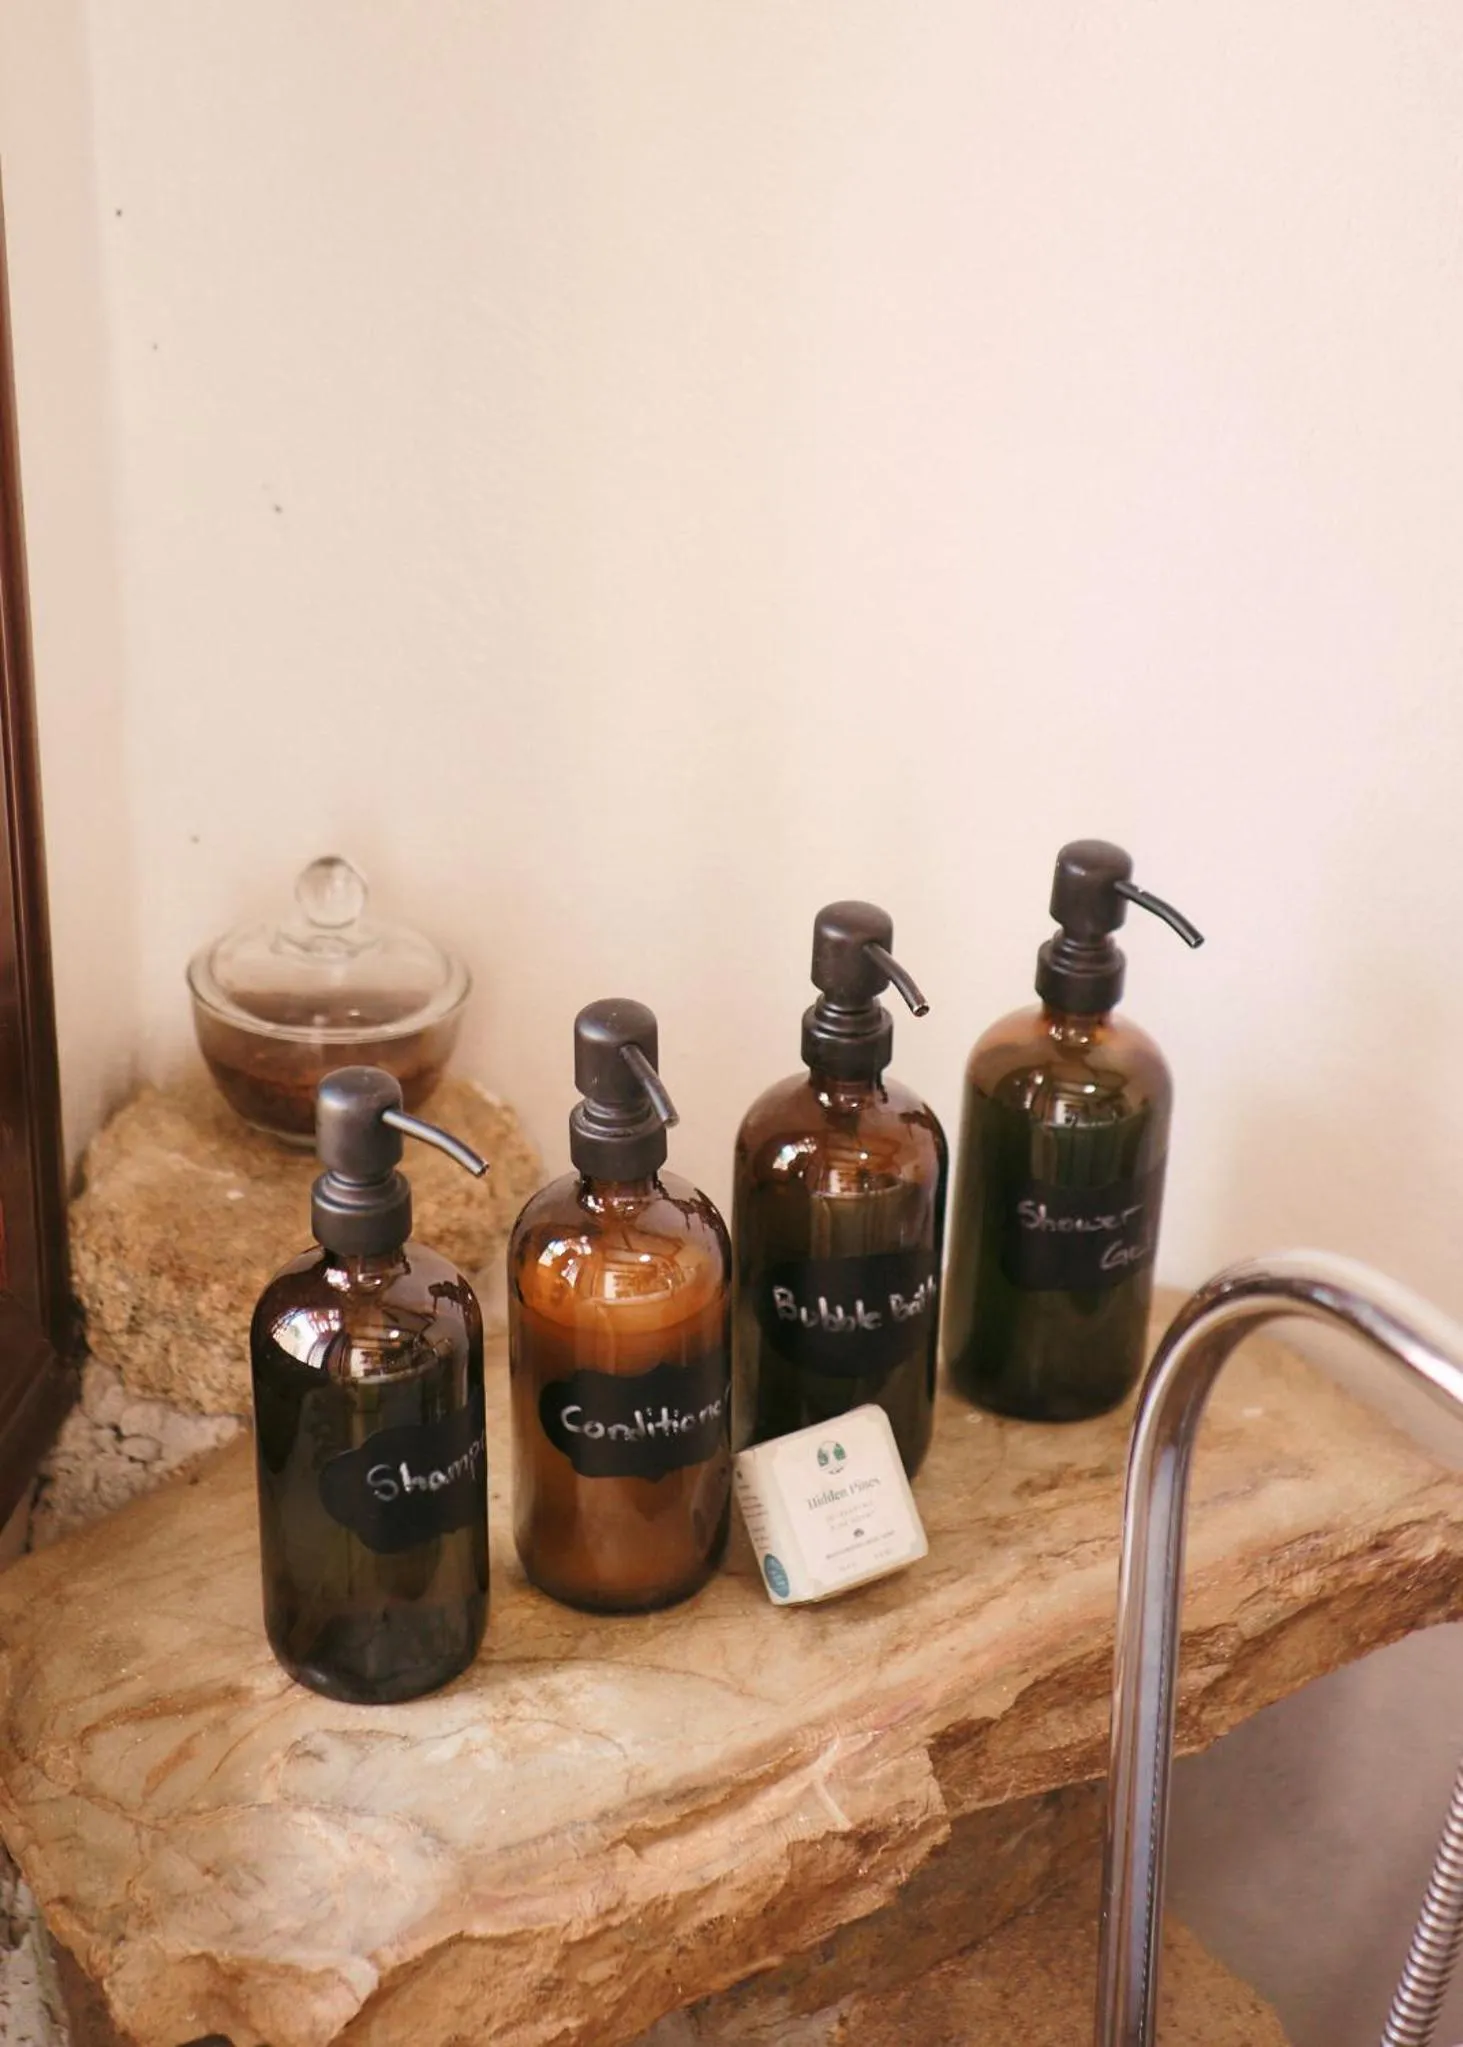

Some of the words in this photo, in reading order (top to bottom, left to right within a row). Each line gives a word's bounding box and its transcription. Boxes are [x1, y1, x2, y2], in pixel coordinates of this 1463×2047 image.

[1018, 1199, 1144, 1232] Shower
[772, 1285, 882, 1332] Bubble
[807, 1489, 849, 1511] Hidden
